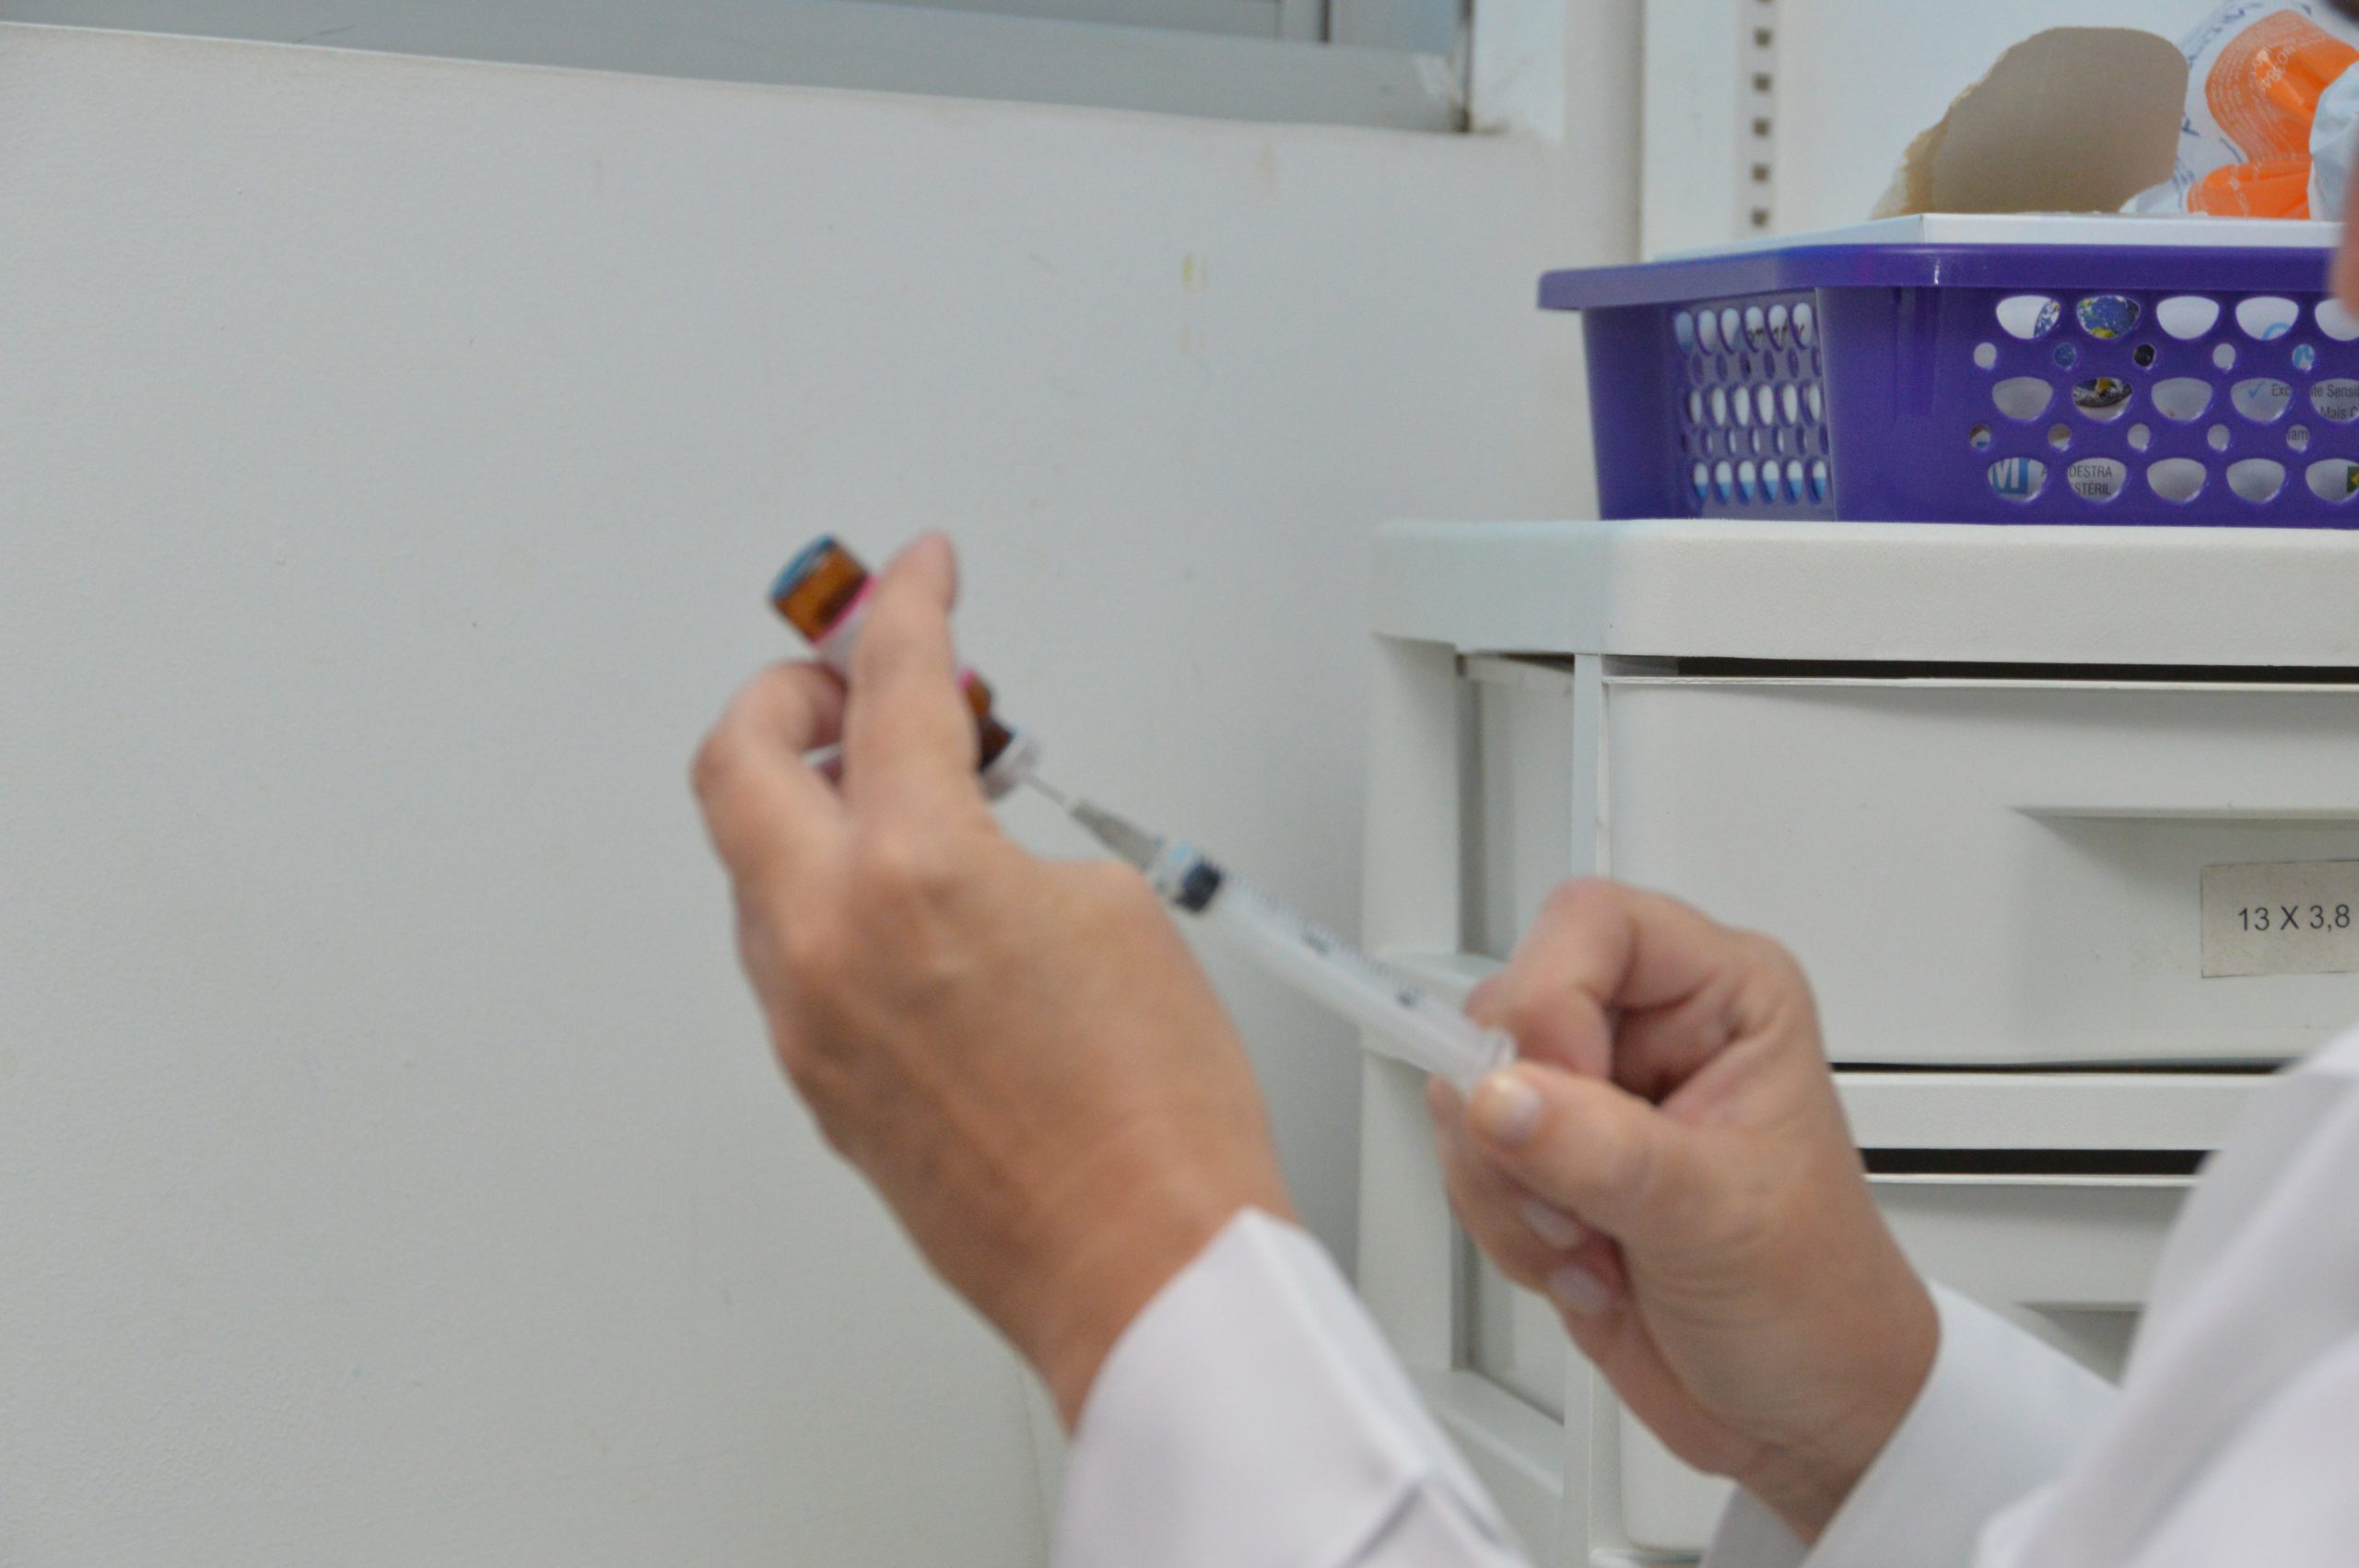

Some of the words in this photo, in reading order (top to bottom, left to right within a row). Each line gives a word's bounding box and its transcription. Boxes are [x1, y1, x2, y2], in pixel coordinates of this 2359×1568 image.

[2328, 383, 2359, 399] Sensi
[2074, 480, 2111, 496] STÉRIL
[2238, 907, 2270, 931] 13
[2280, 906, 2300, 930] X
[2309, 904, 2351, 932] 3,8
